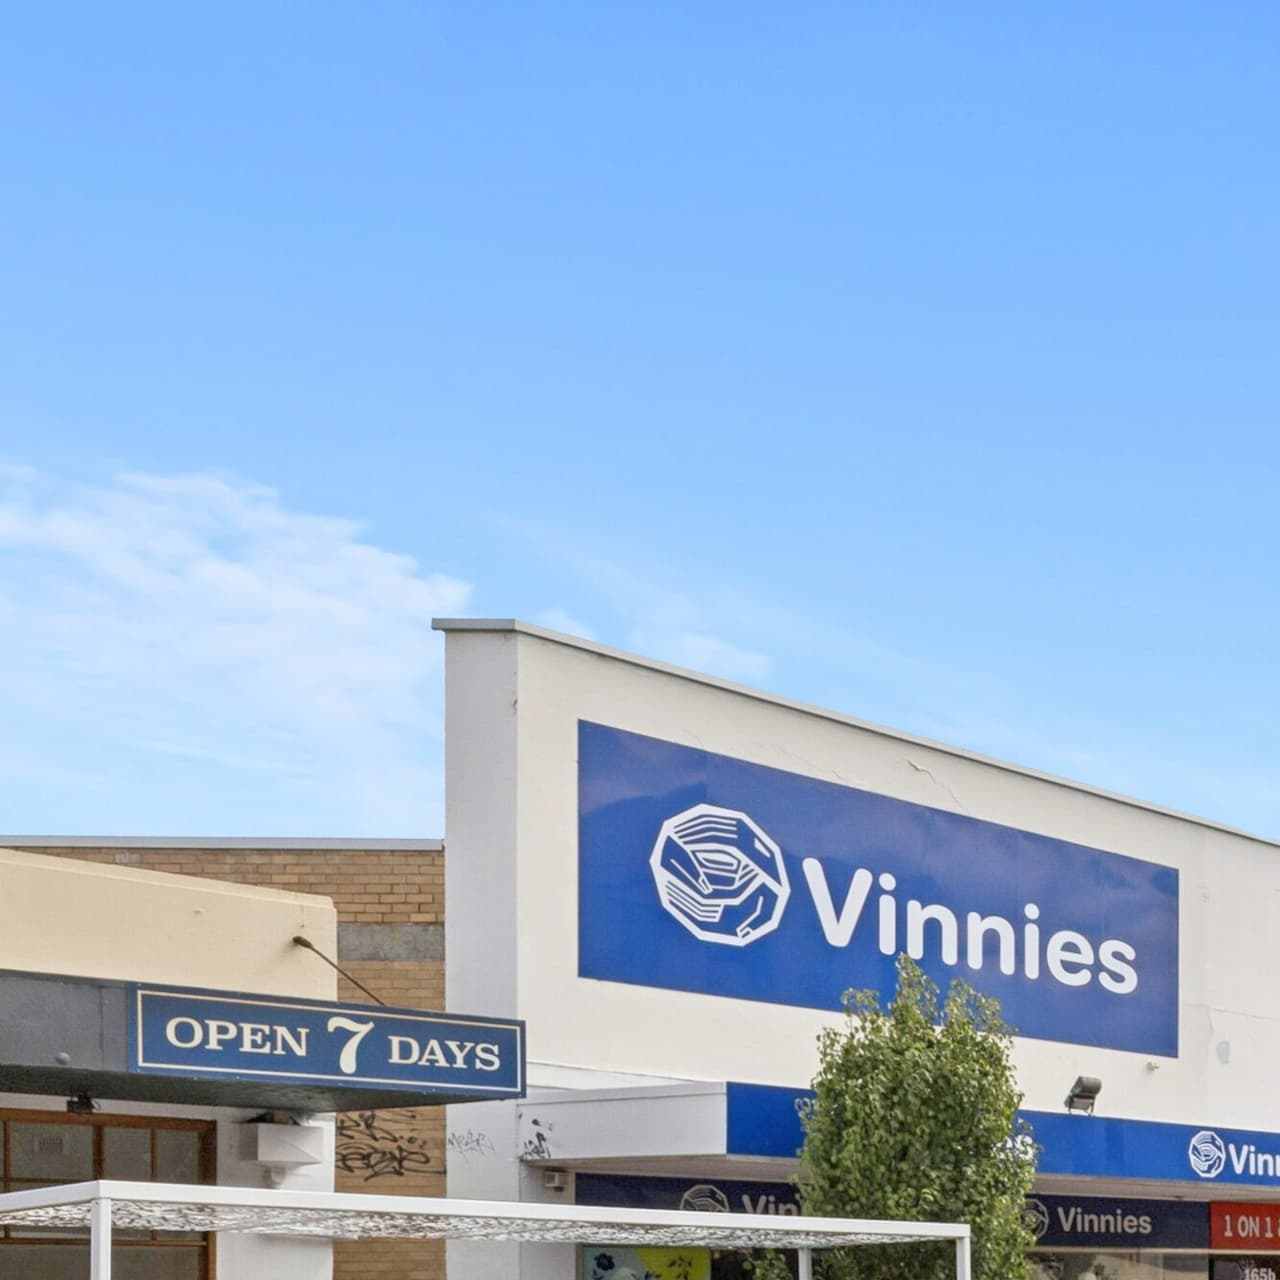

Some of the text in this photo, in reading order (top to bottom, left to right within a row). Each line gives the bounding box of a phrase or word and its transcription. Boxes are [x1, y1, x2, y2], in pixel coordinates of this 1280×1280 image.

[802, 856, 1139, 995] Vinnies
[165, 1016, 501, 1074] OPEN 7 DAYS
[1057, 1206, 1152, 1234] Vinnies
[1224, 1214, 1233, 1237] 1
[1237, 1215, 1260, 1238] ON
[1264, 1216, 1274, 1238] 1
